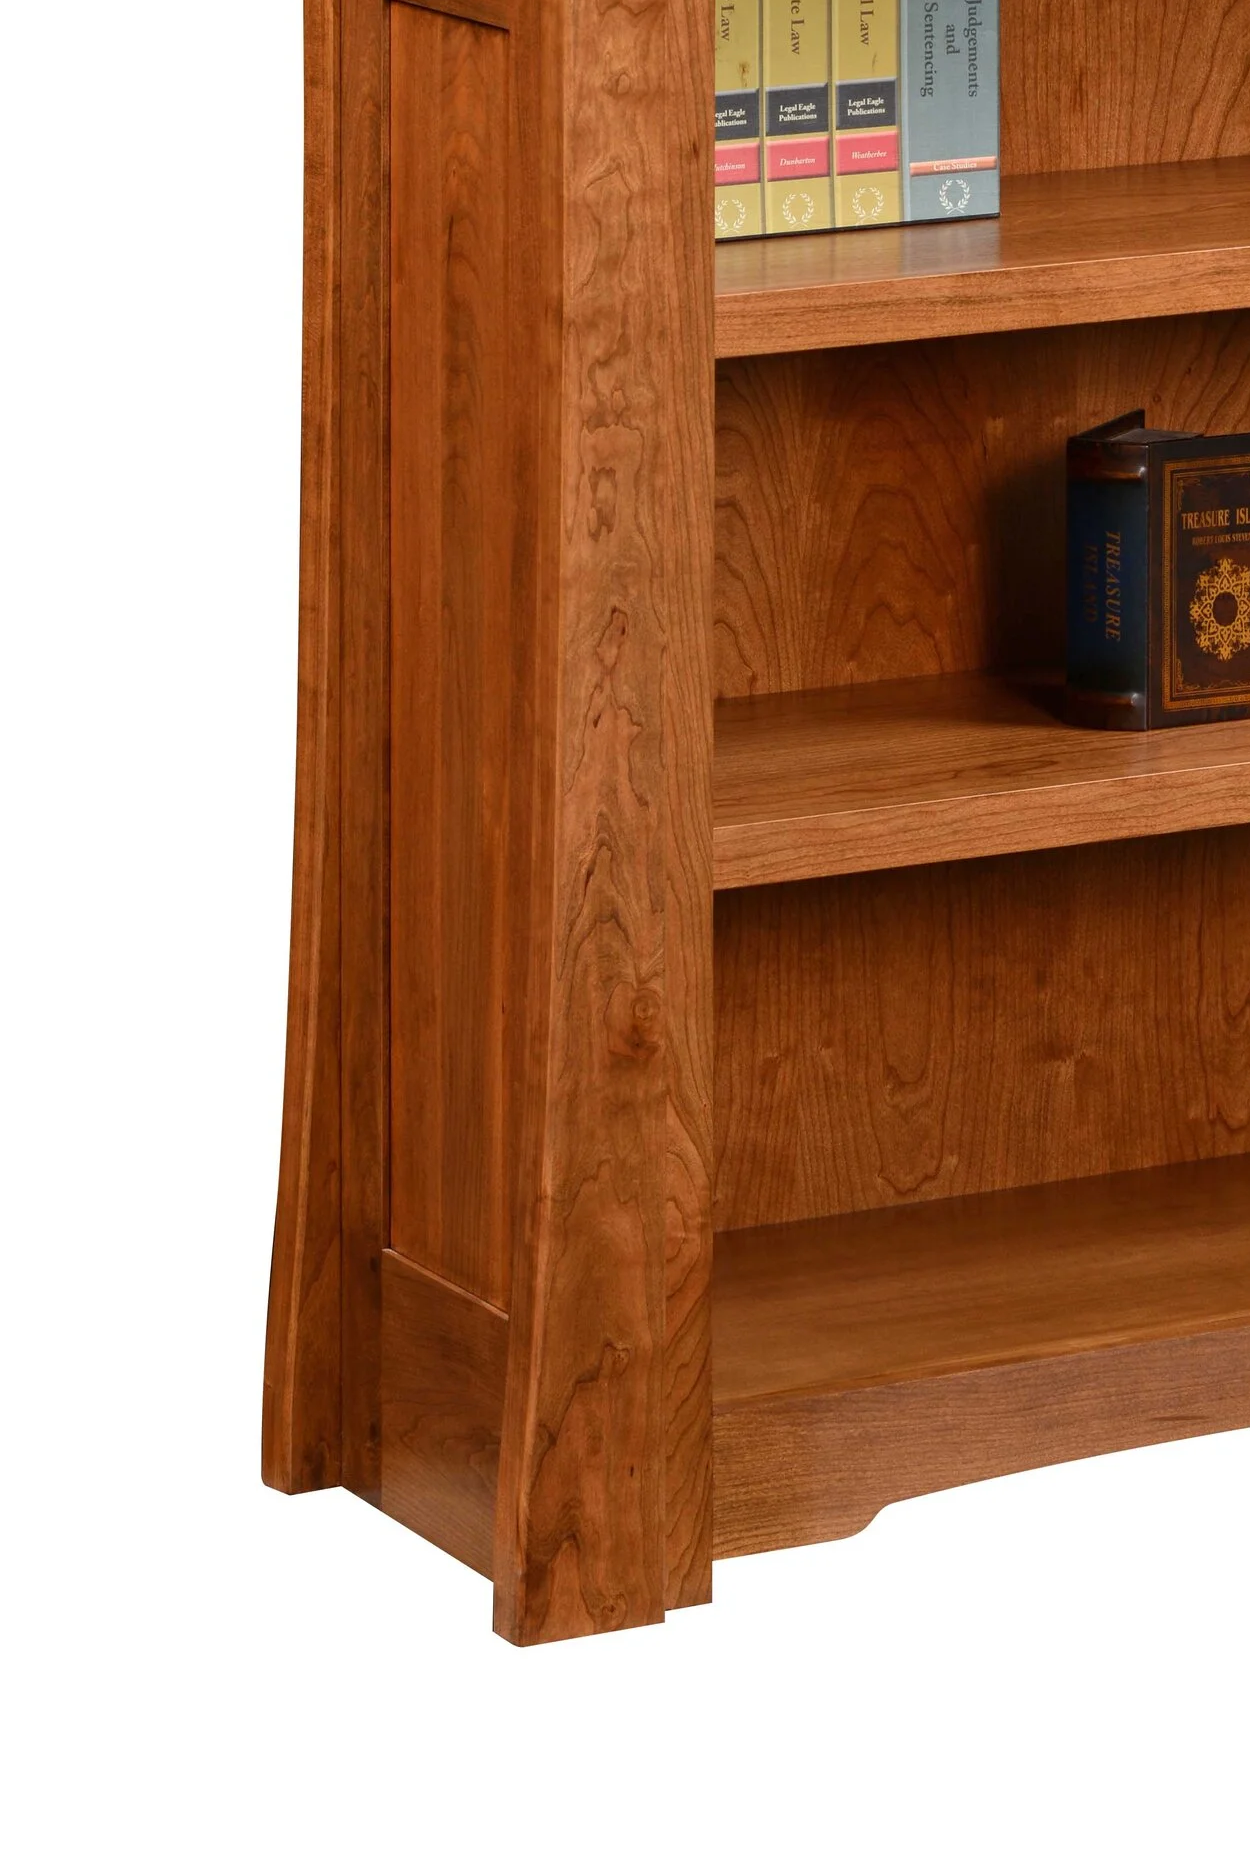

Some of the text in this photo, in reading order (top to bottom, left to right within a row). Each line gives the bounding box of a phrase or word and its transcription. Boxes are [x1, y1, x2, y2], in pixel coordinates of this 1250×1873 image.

[720, 4, 735, 41] Law
[860, 9, 874, 46] Law
[791, 19, 805, 55] Law
[946, 23, 960, 55] and
[920, 2, 939, 98] Sentencing
[779, 102, 816, 113] Legal Eagle
[848, 97, 884, 107] Legal Eagle
[715, 108, 746, 119] egal Eagle
[778, 112, 818, 122] Publications
[847, 106, 886, 116] Publications
[715, 161, 746, 172] utchinson
[933, 161, 977, 172] Case Studies
[1181, 509, 1230, 530] TREASURE
[1105, 530, 1121, 642] TREASURE
